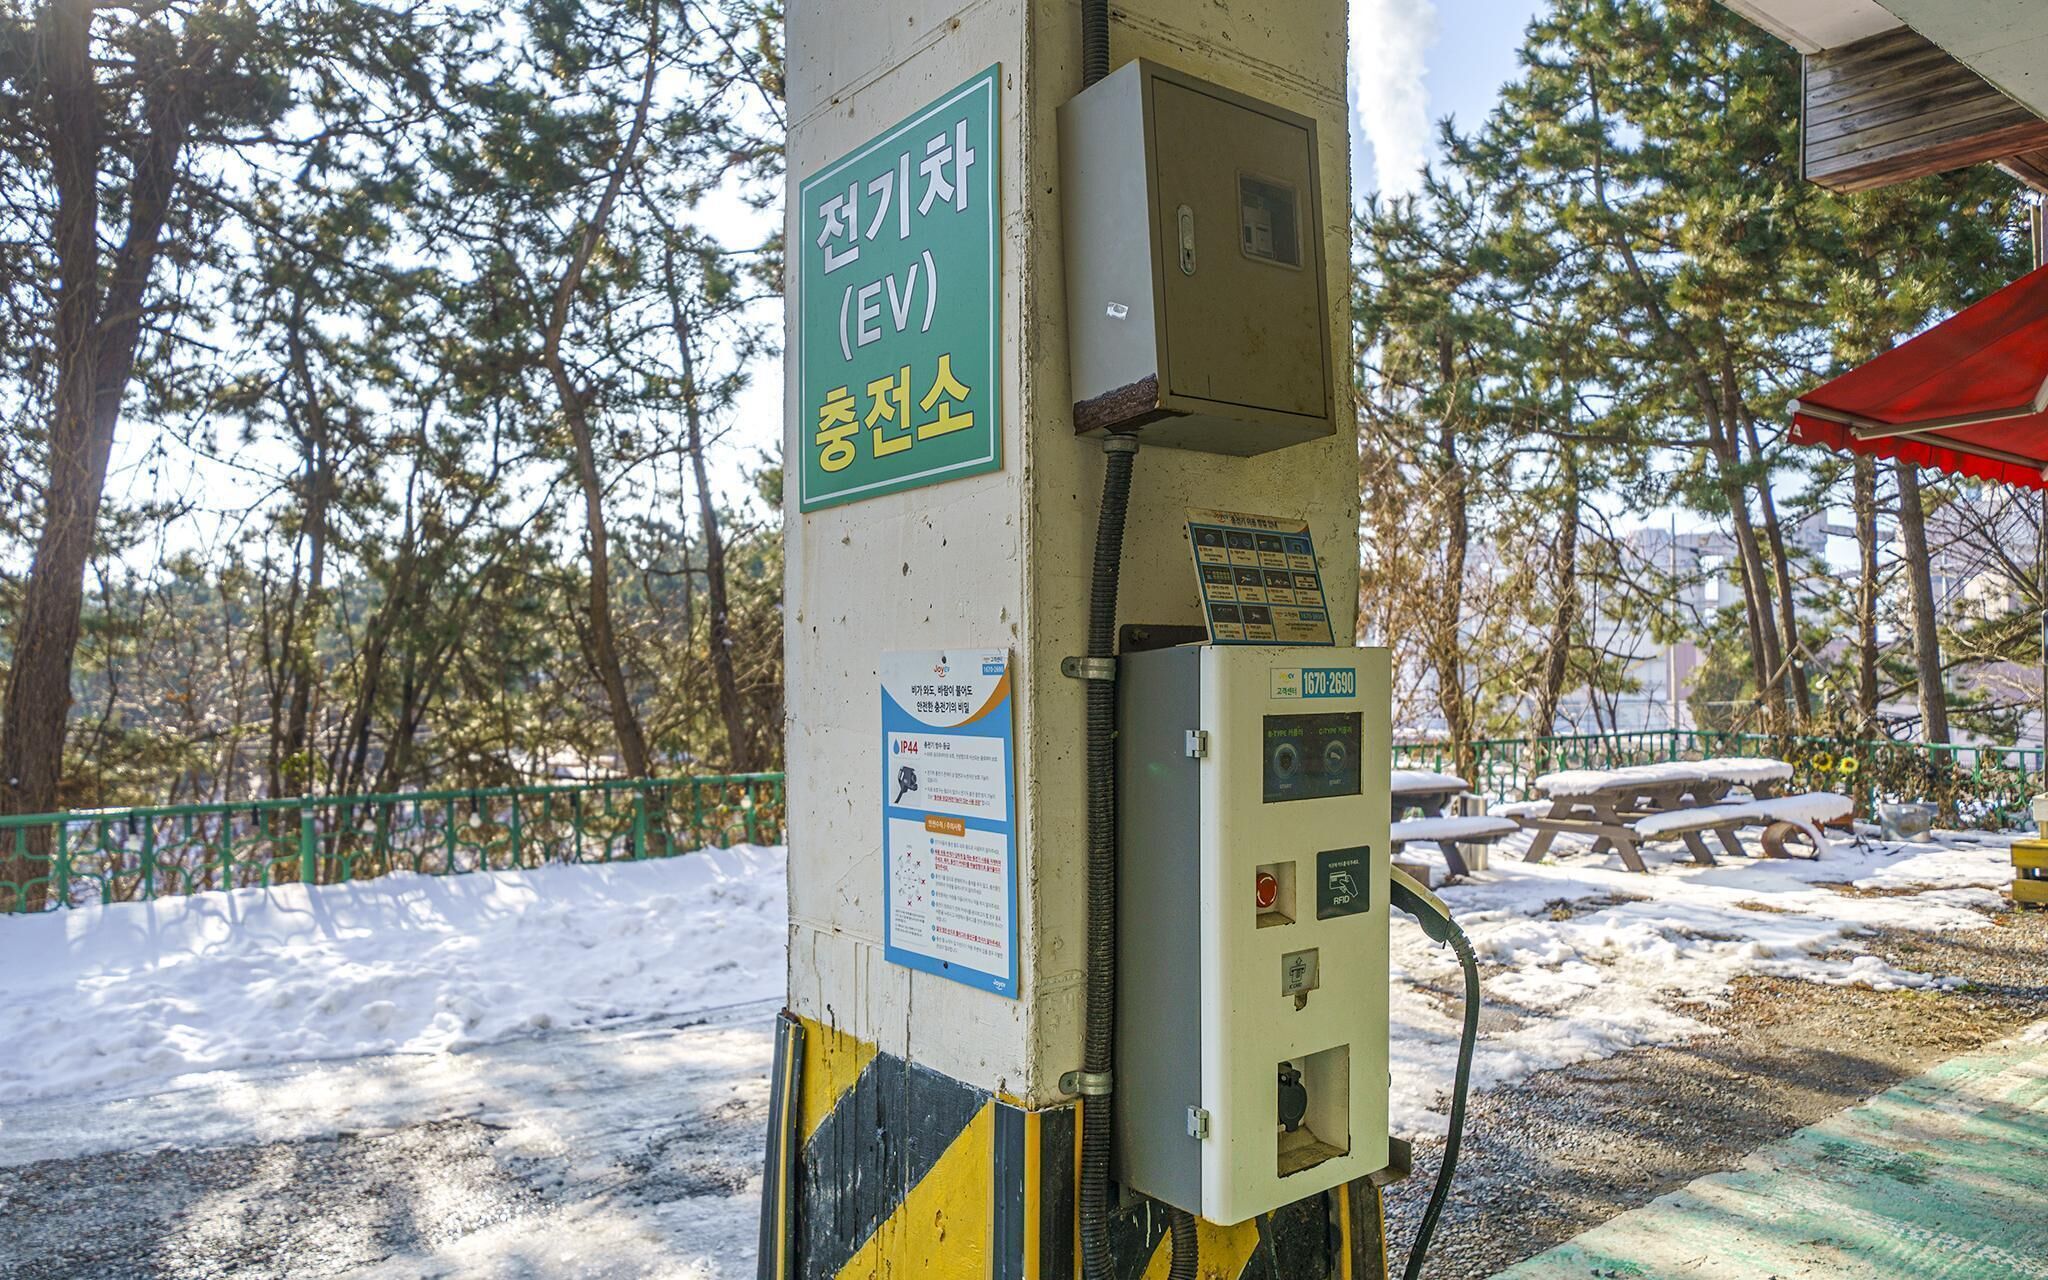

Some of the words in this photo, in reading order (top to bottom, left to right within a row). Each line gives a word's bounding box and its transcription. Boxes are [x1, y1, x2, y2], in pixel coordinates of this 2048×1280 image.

[817, 117, 975, 275] 전기차
[839, 249, 938, 361] (EV)
[814, 352, 975, 473] 충전소
[900, 740, 919, 754] IP44
[1333, 895, 1350, 905] RFID
